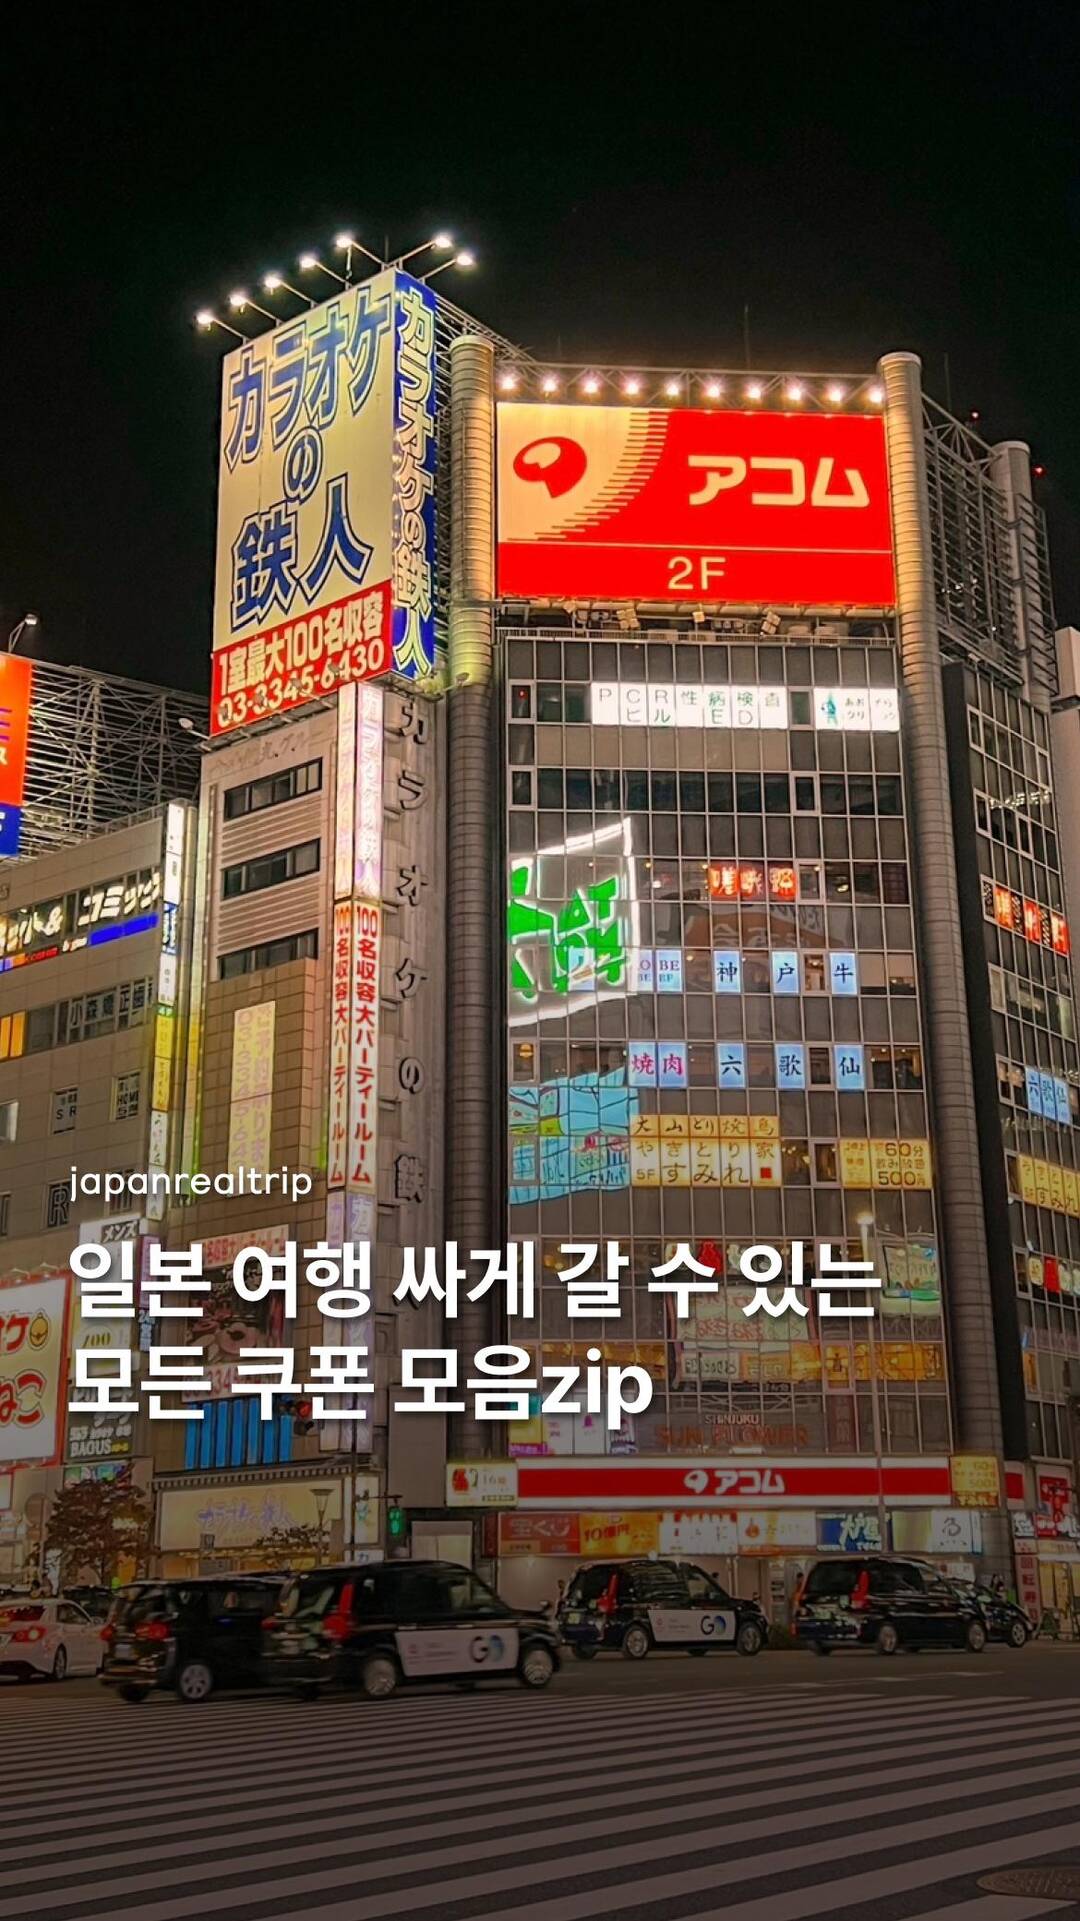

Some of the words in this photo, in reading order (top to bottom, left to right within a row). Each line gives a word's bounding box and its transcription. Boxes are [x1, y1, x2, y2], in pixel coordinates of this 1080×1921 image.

[223, 285, 392, 470] カラオケ
[282, 424, 322, 508] の
[394, 285, 434, 678] カラオケの鉄人
[688, 455, 870, 508] アコム
[230, 471, 374, 633] 鉄人
[668, 556, 726, 590] 2F
[219, 588, 385, 698] 1室最大100名収容
[217, 636, 386, 729] 03-3345-6430
[639, 958, 680, 971] OBE
[716, 961, 855, 984] 神戸牛
[395, 699, 429, 1310] カラオケの鉄
[631, 1054, 684, 1077] 焼肉
[721, 1054, 860, 1077] 六歌仙
[636, 1140, 775, 1159] やきとり家
[662, 1162, 749, 1184] すみれ
[0, 1314, 30, 1352] ケ
[715, 1469, 785, 1495] アコム
